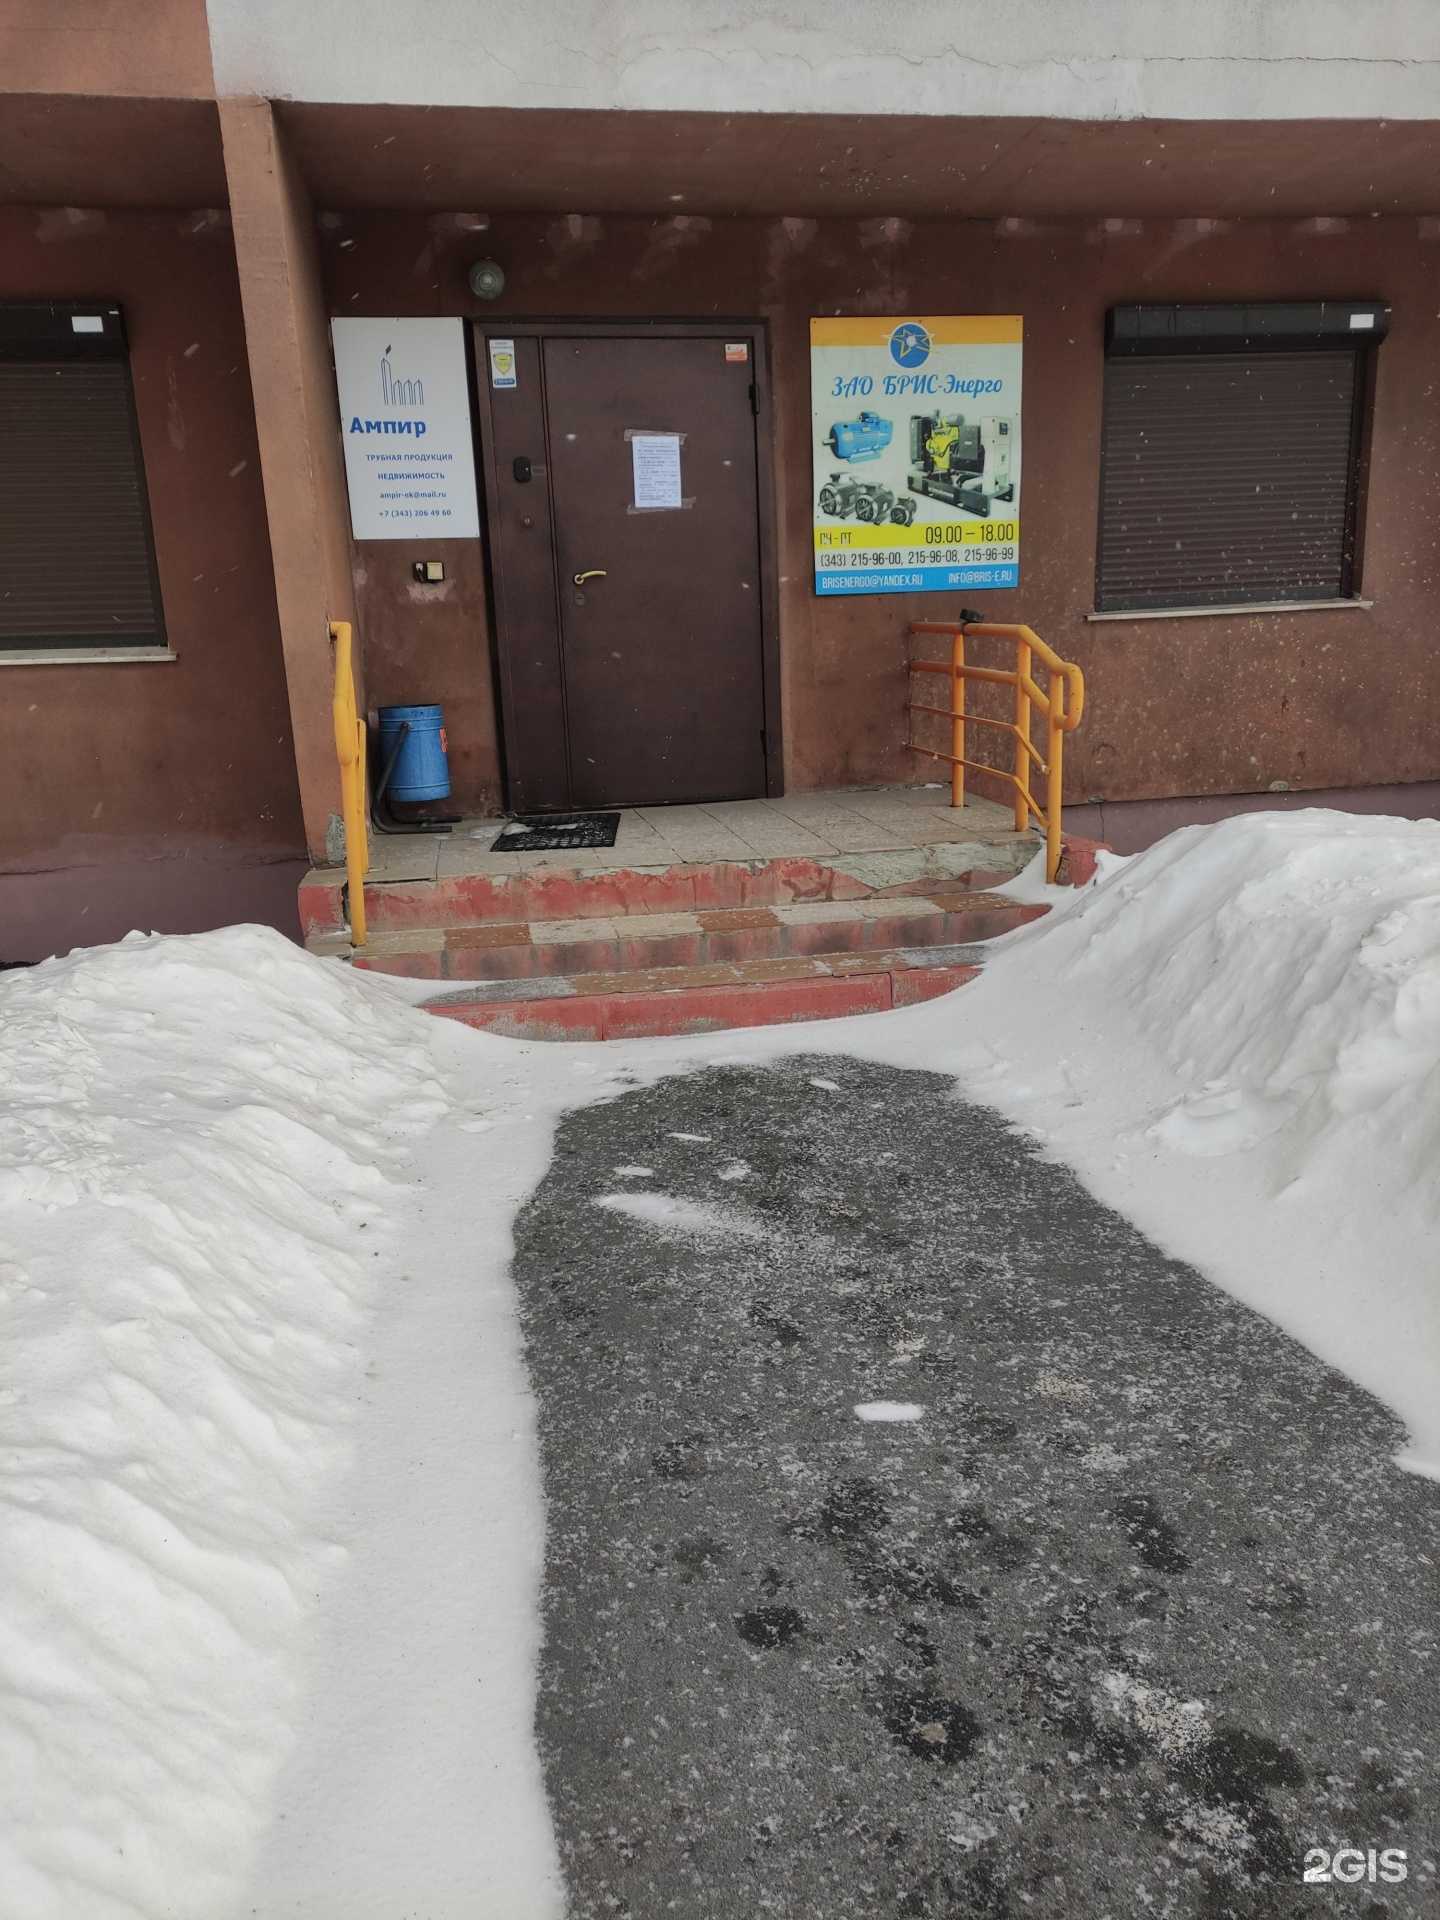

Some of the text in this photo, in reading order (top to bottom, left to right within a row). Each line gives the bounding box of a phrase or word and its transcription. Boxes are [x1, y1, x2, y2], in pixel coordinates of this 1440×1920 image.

[832, 374, 1003, 398] ЗАО БРИС-Энерго
[350, 417, 426, 438] Ампир
[404, 454, 453, 462] ПРОДУКЦИЯ
[378, 472, 445, 481] НЕДВИЖИМОСТЬ
[391, 509, 412, 518] (343)
[840, 532, 852, 545] ПТ
[925, 526, 962, 544] 09.00
[980, 523, 1014, 542] 18.00
[820, 547, 1014, 567] (343) 215-96-00, 215-96-08, 215-96-99
[822, 570, 1012, 589] BRISENERGO@YANDEX.RU INFO@BRIS-E.RU
